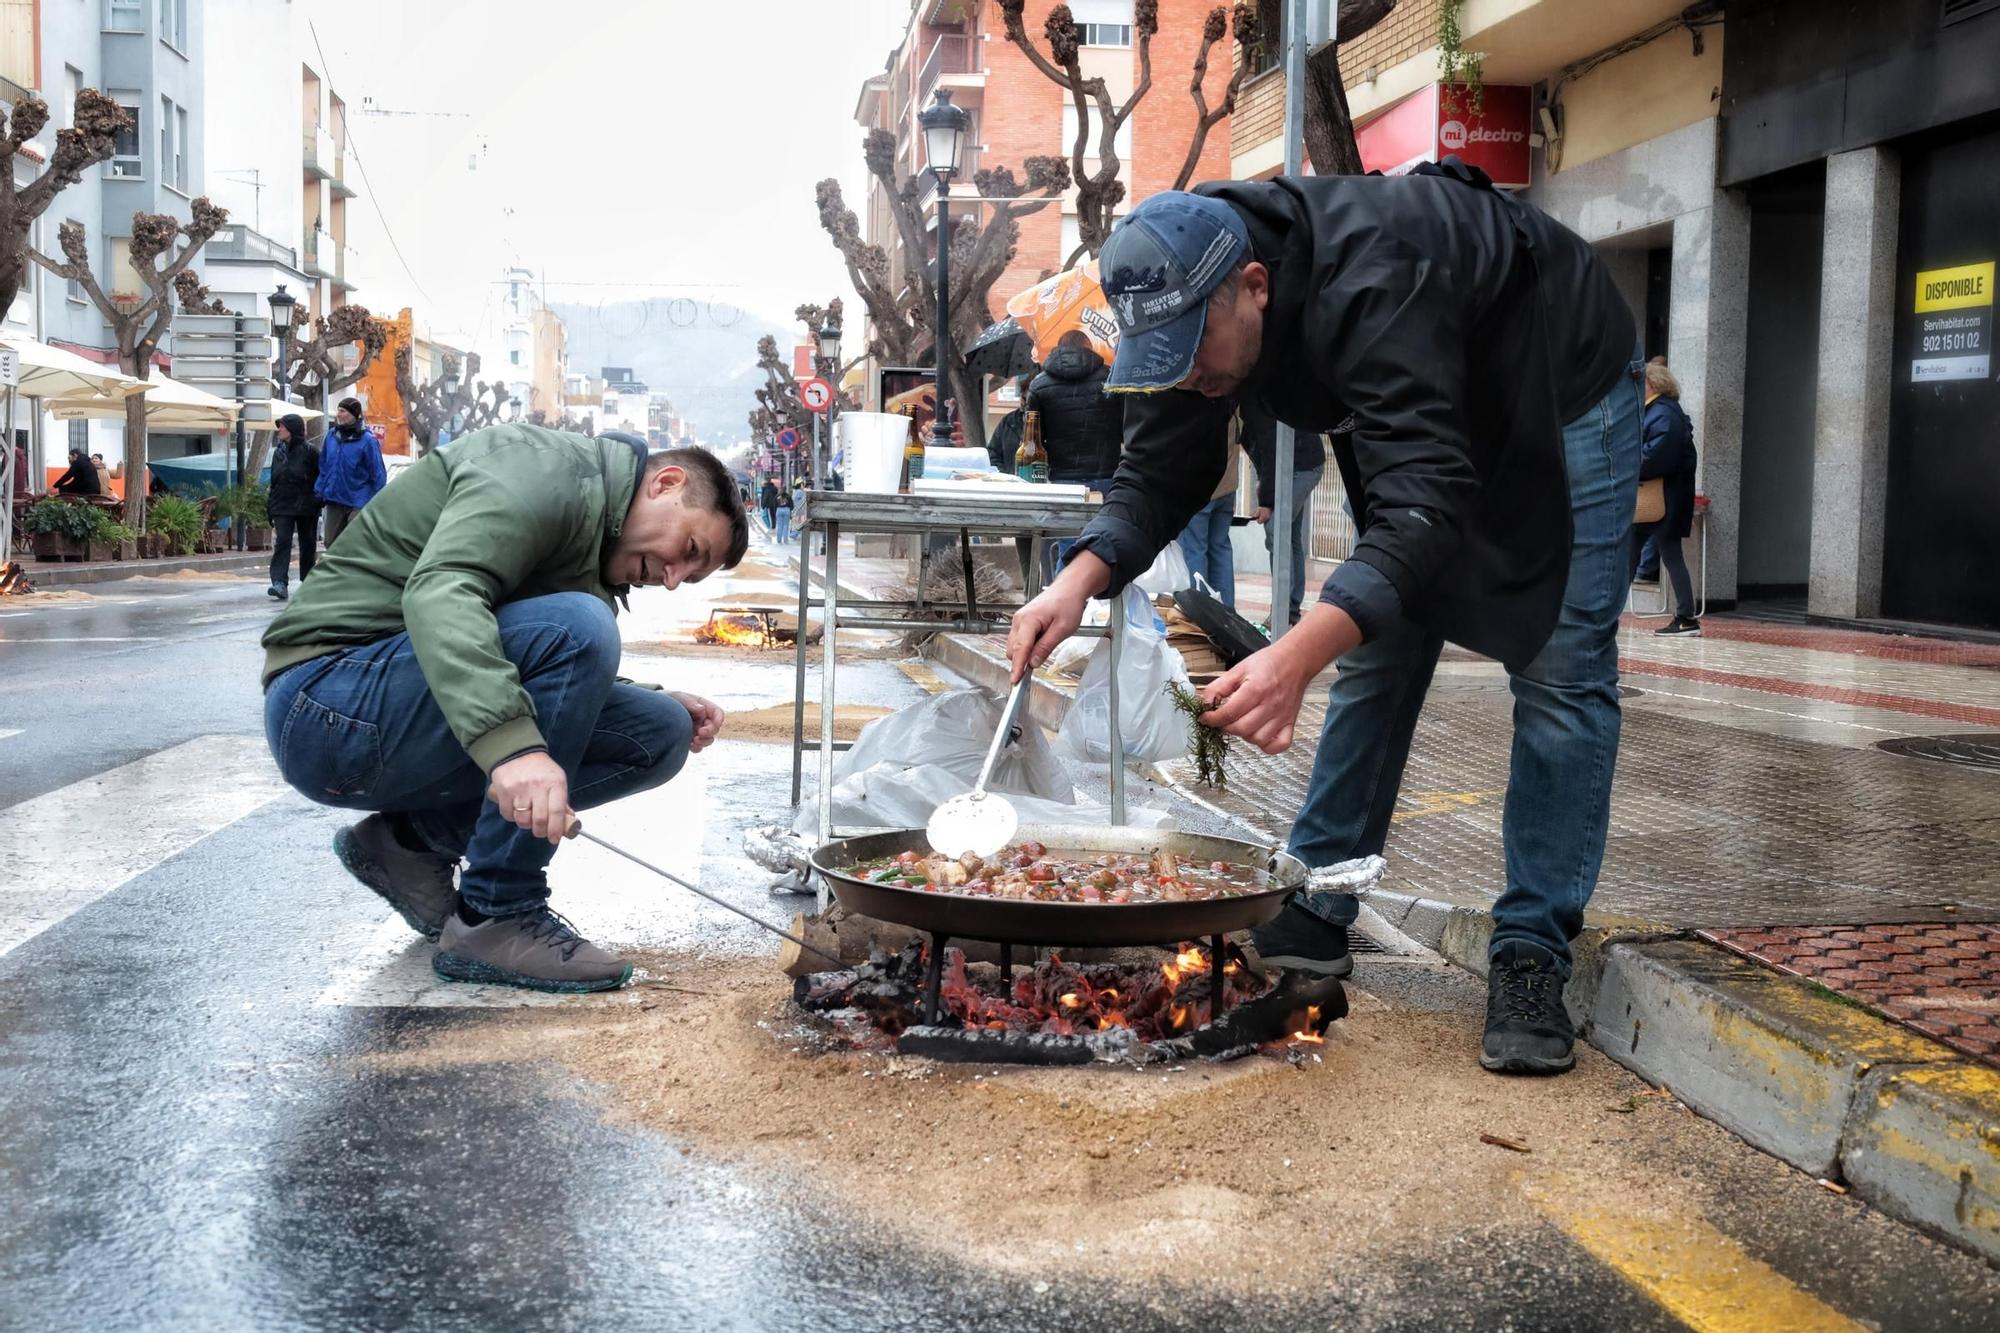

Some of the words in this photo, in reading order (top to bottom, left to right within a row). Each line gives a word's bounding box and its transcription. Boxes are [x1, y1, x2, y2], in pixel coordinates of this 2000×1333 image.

[1445, 129, 1462, 140] mi
[1468, 126, 1525, 144] electro
[1926, 276, 1983, 301] DISPONIBLE
[1141, 289, 1181, 309] VARIATION
[1923, 316, 1981, 332] Servihabitat.com
[1923, 335, 1940, 352] 902
[1942, 334, 1952, 350] 15
[1953, 333, 1964, 349] 01
[1967, 332, 1980, 348] 02
